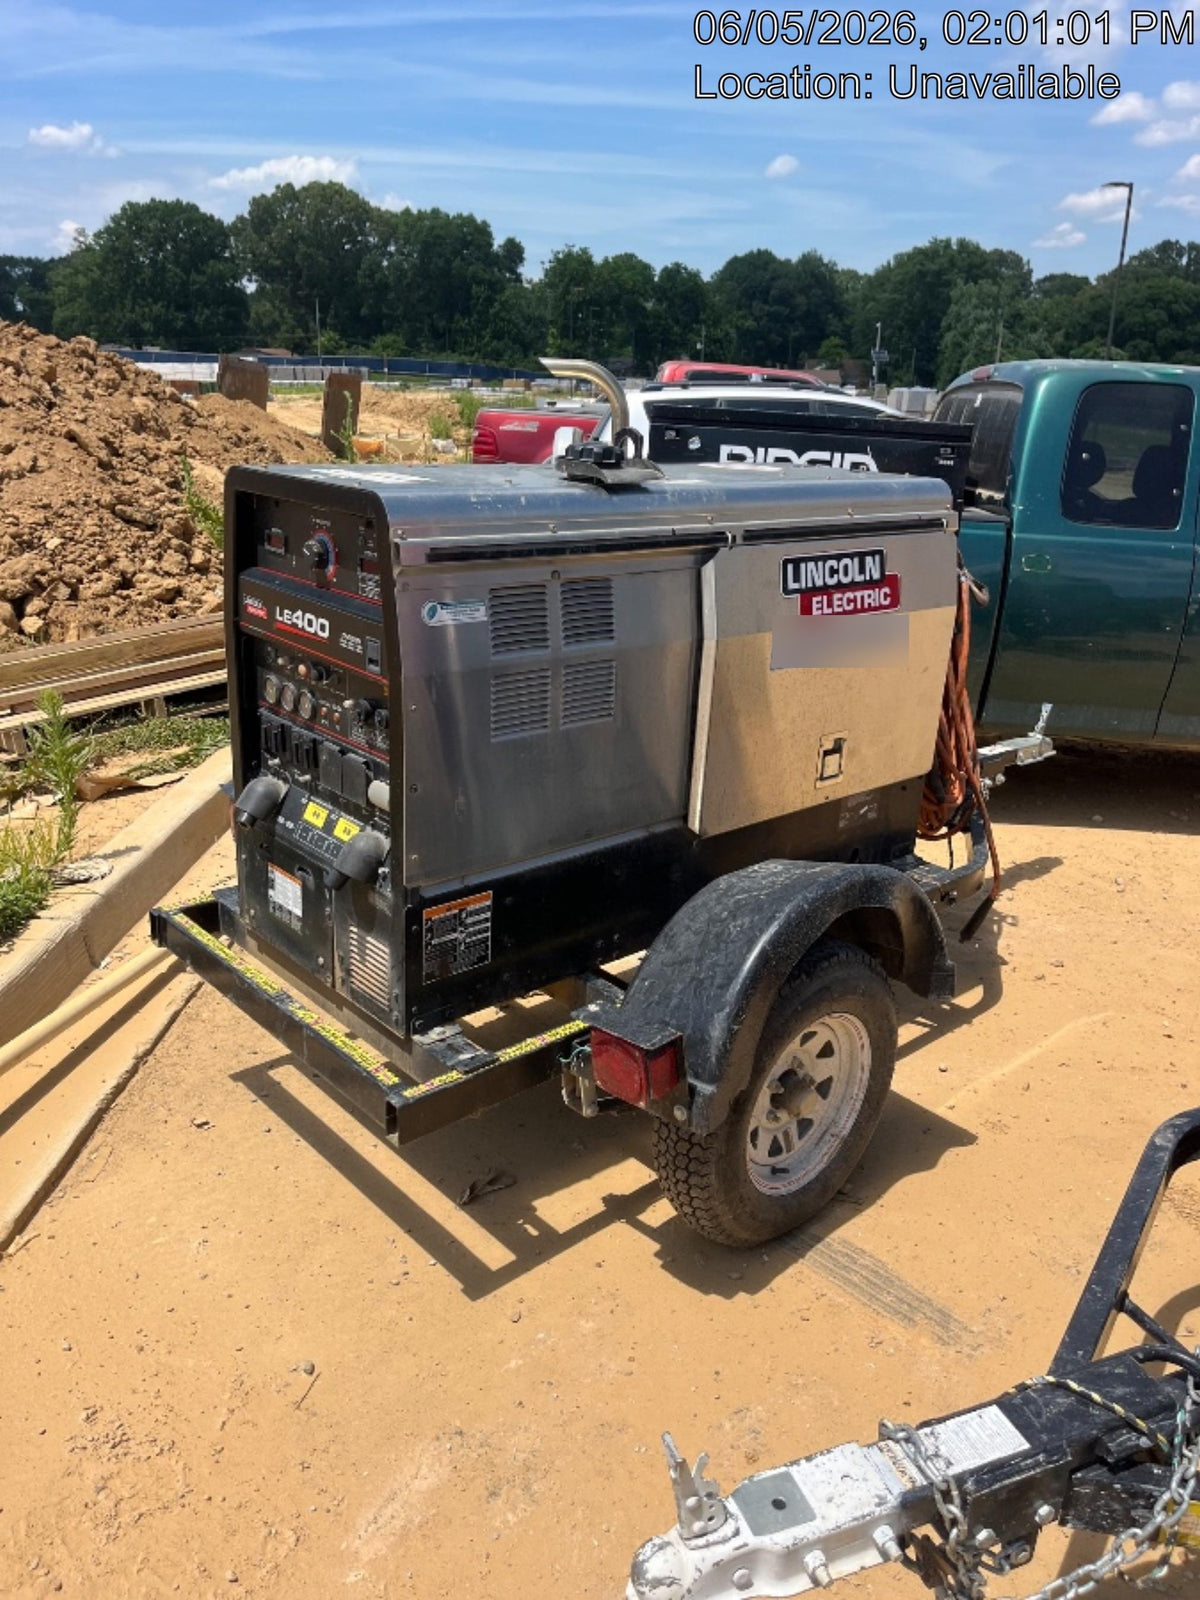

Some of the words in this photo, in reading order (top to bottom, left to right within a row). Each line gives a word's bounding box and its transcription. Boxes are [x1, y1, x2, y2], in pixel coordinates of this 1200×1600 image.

[786, 554, 881, 590] LINCOLN
[811, 587, 892, 616] ELECTRIC
[275, 606, 330, 639] LE400
